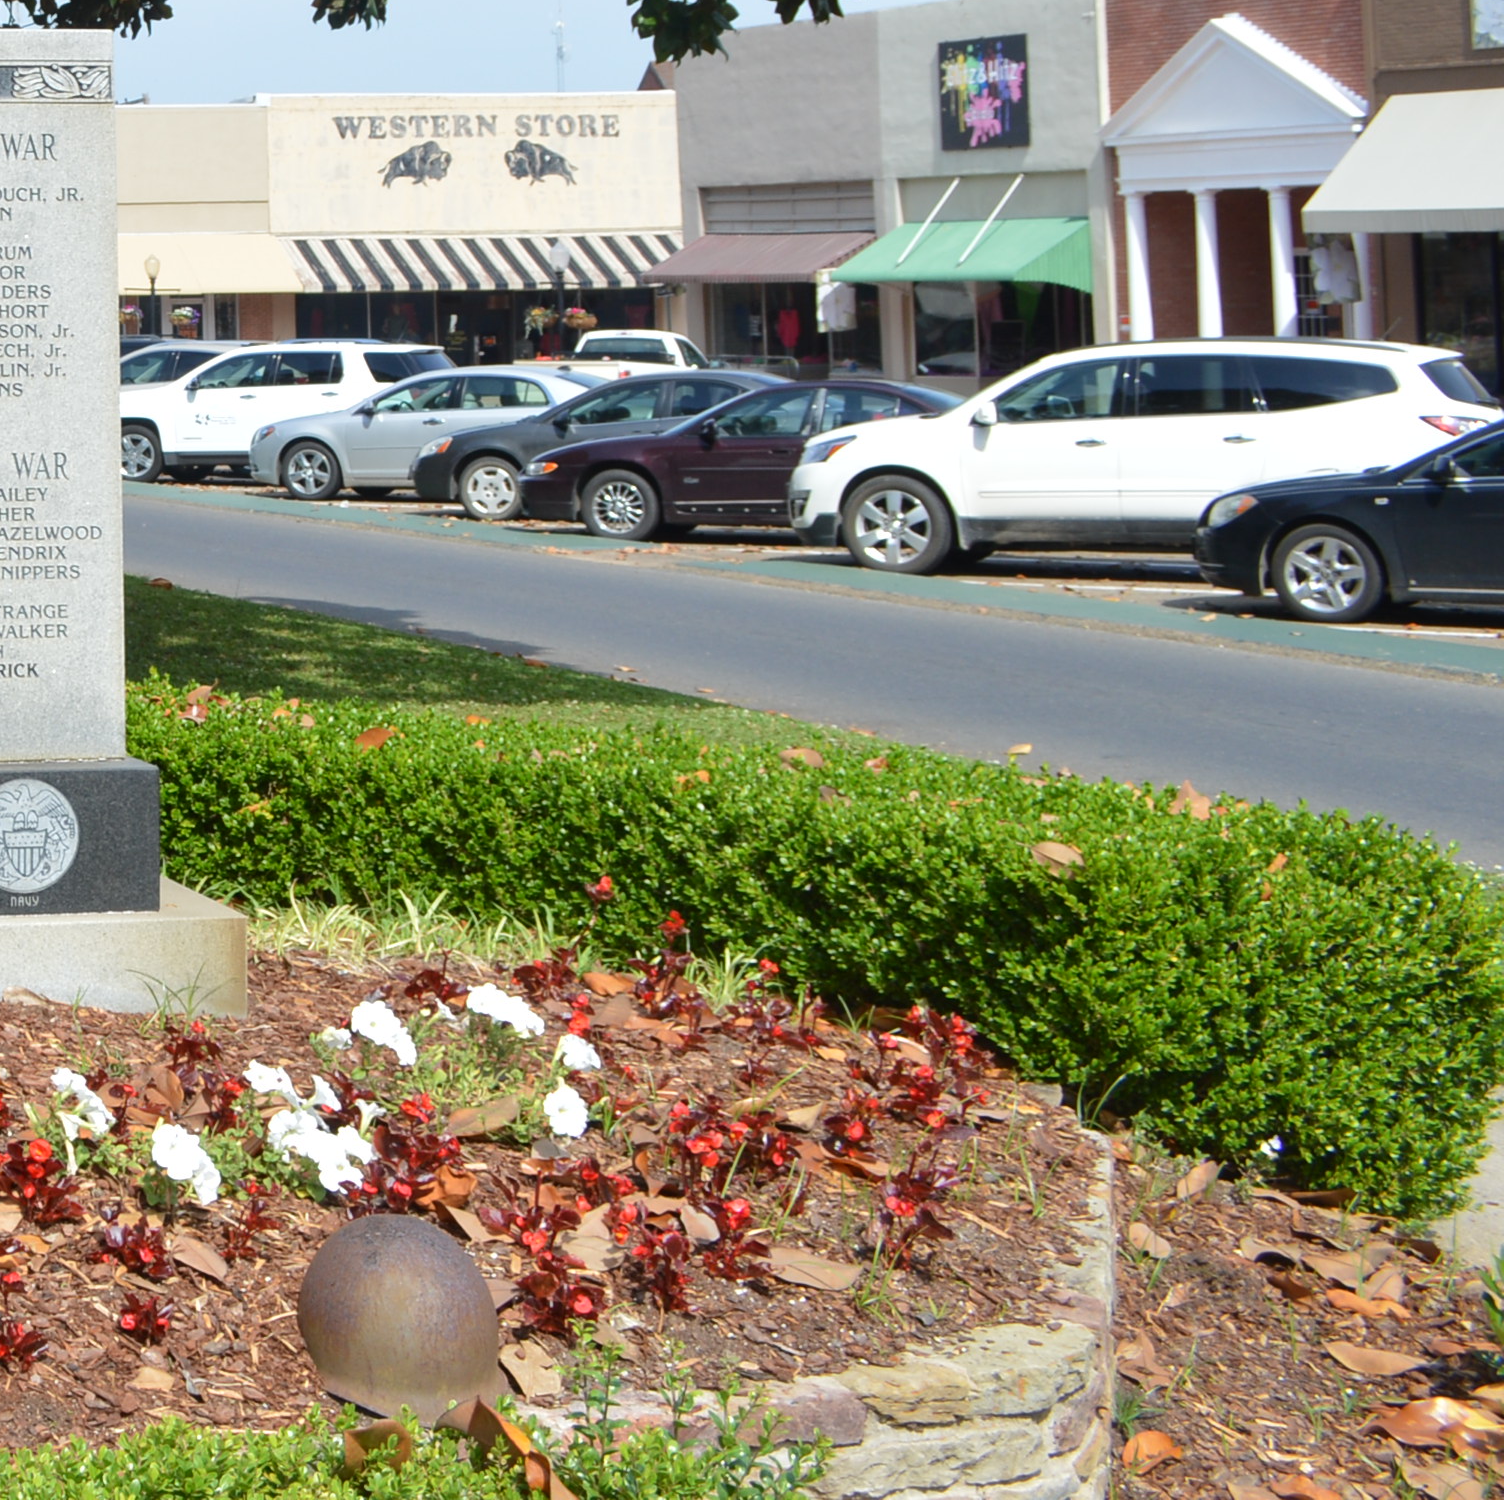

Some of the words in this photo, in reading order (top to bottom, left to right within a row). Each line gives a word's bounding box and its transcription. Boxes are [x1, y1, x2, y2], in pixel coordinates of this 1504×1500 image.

[333, 115, 497, 139] WESTERN
[515, 114, 620, 138] STORE
[0, 134, 57, 161] WAR
[56, 188, 83, 201] JR.
[12, 452, 69, 480] WAR
[11, 896, 39, 906] NAVY
